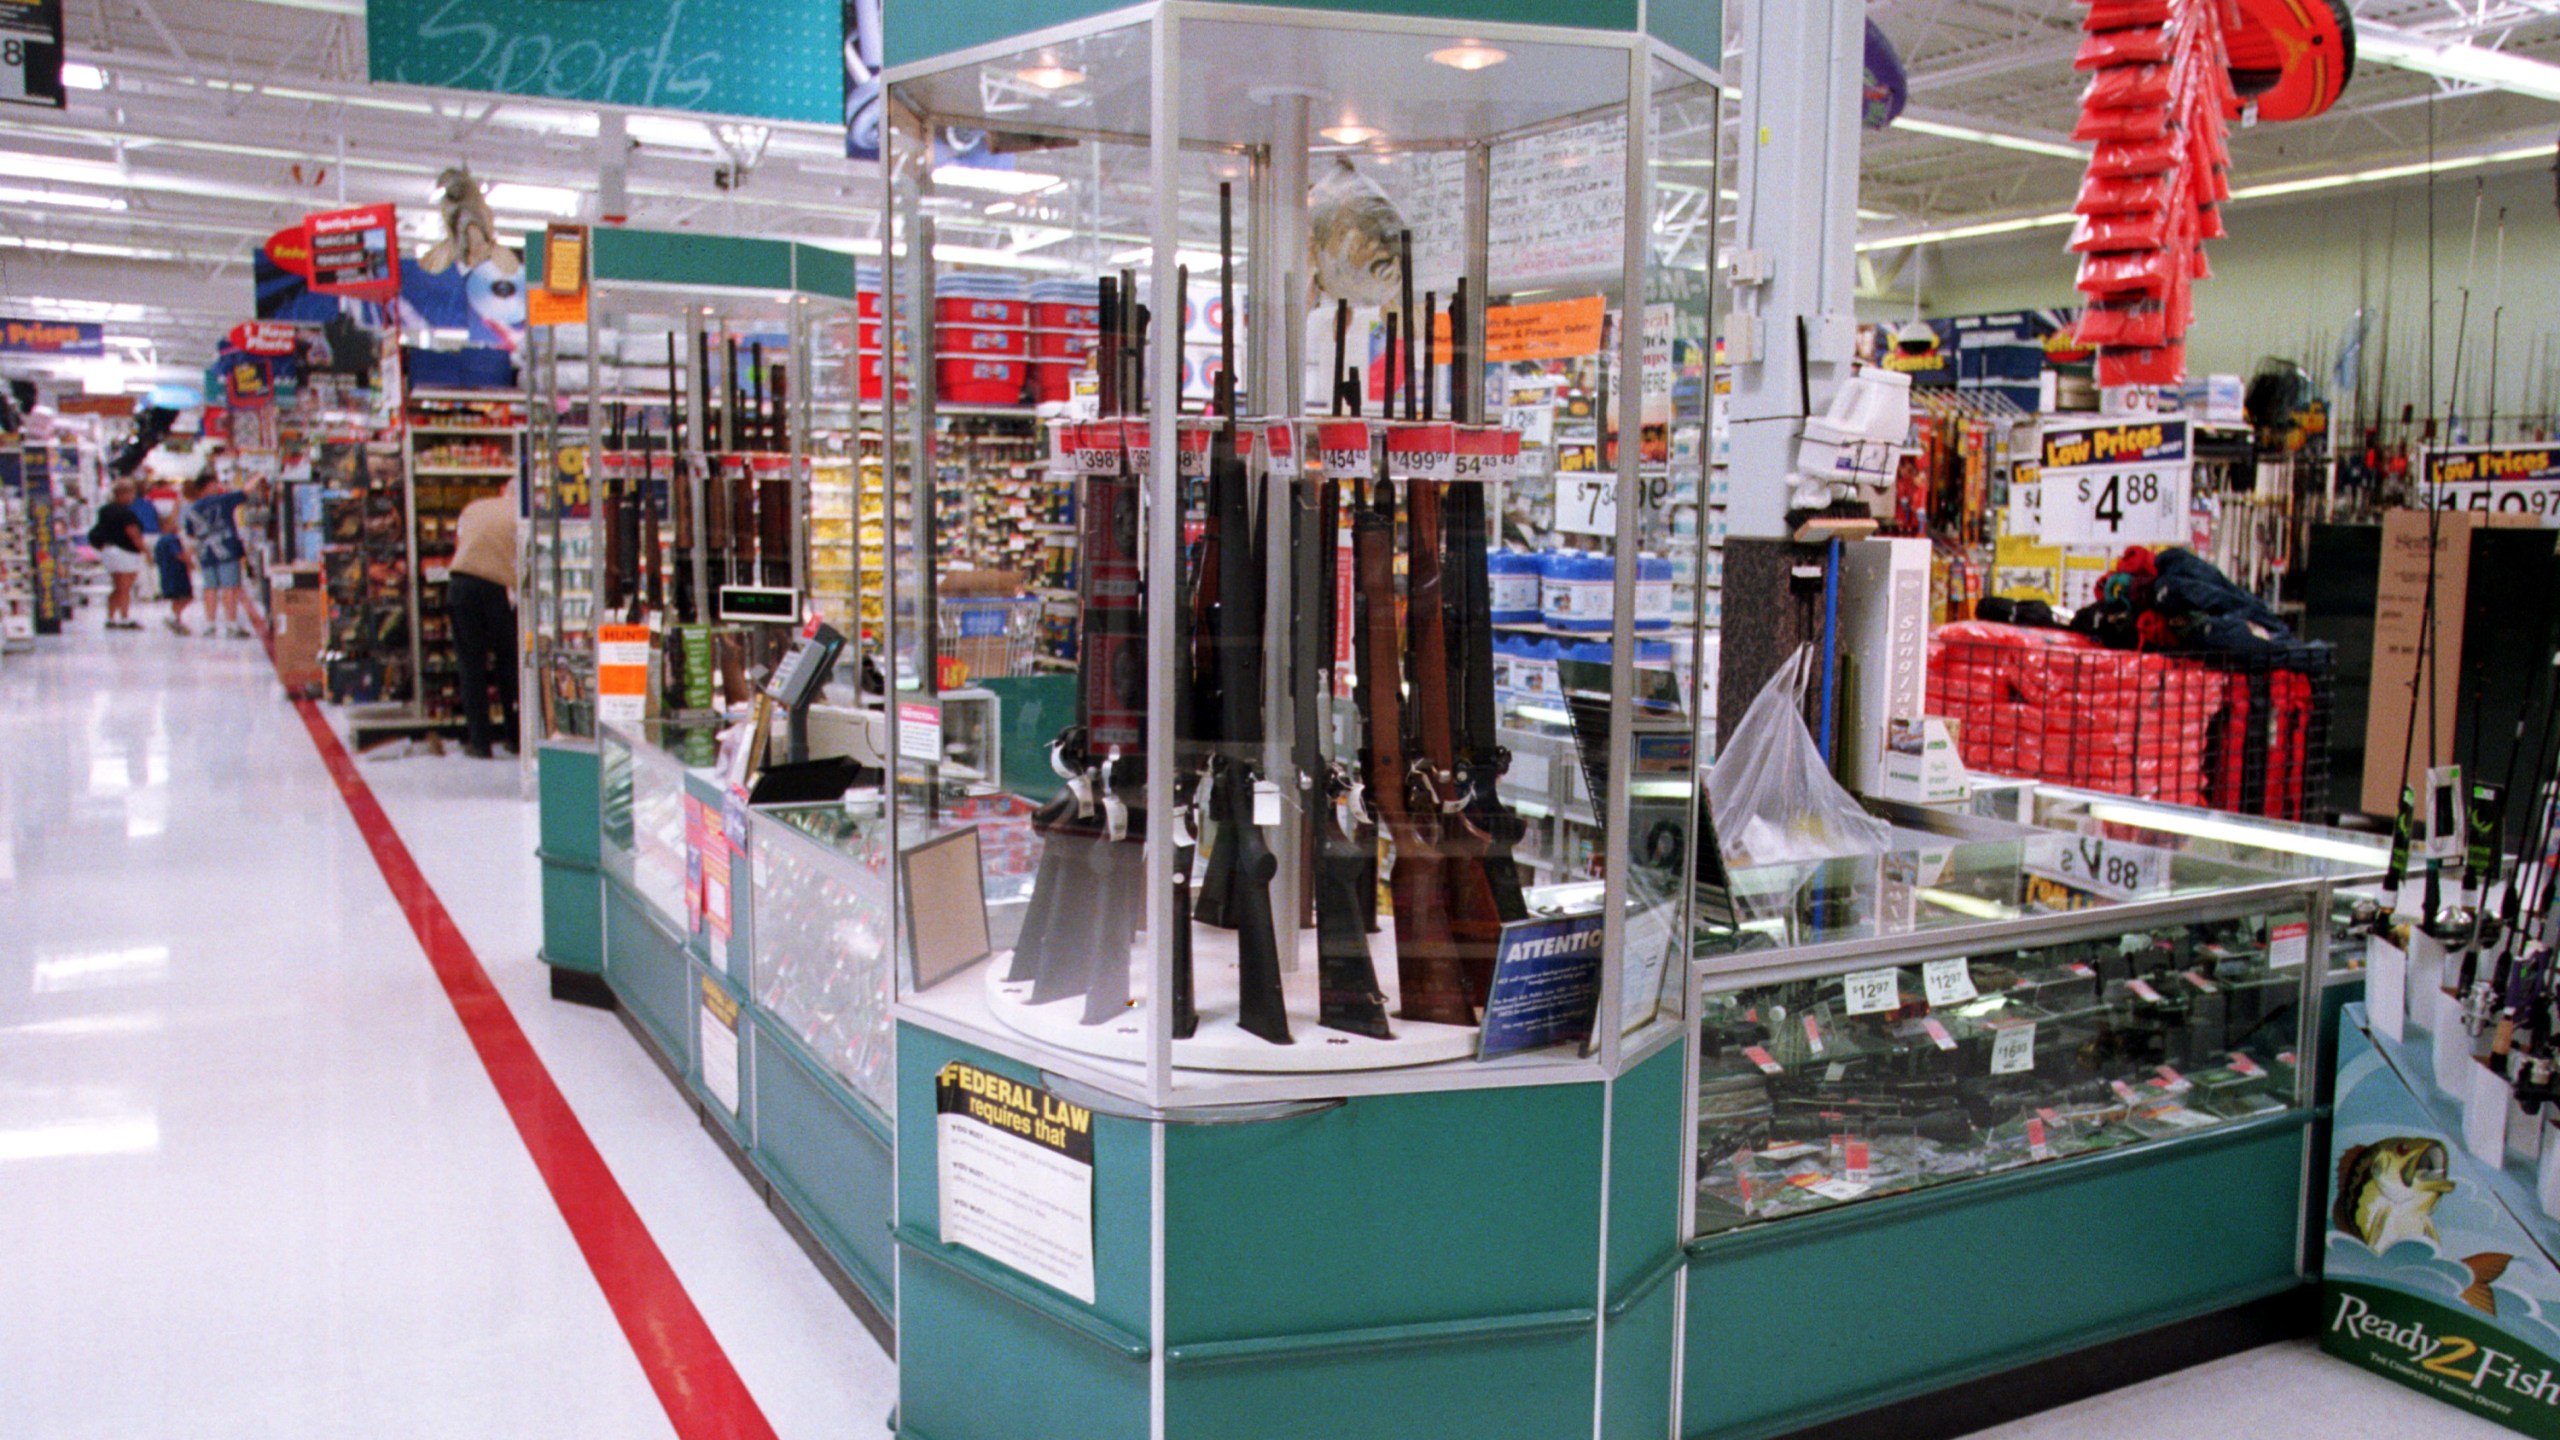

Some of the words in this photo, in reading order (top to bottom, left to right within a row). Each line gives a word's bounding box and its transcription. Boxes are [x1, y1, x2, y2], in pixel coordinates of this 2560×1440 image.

[397, 0, 721, 110] Sports
[2047, 438, 2091, 468] Low
[2093, 423, 2163, 460] Prices
[941, 1064, 1038, 1115] FEDERAL
[1043, 1095, 1090, 1134] LAW
[969, 1096, 1032, 1136] requires
[1035, 1117, 1067, 1149] that
